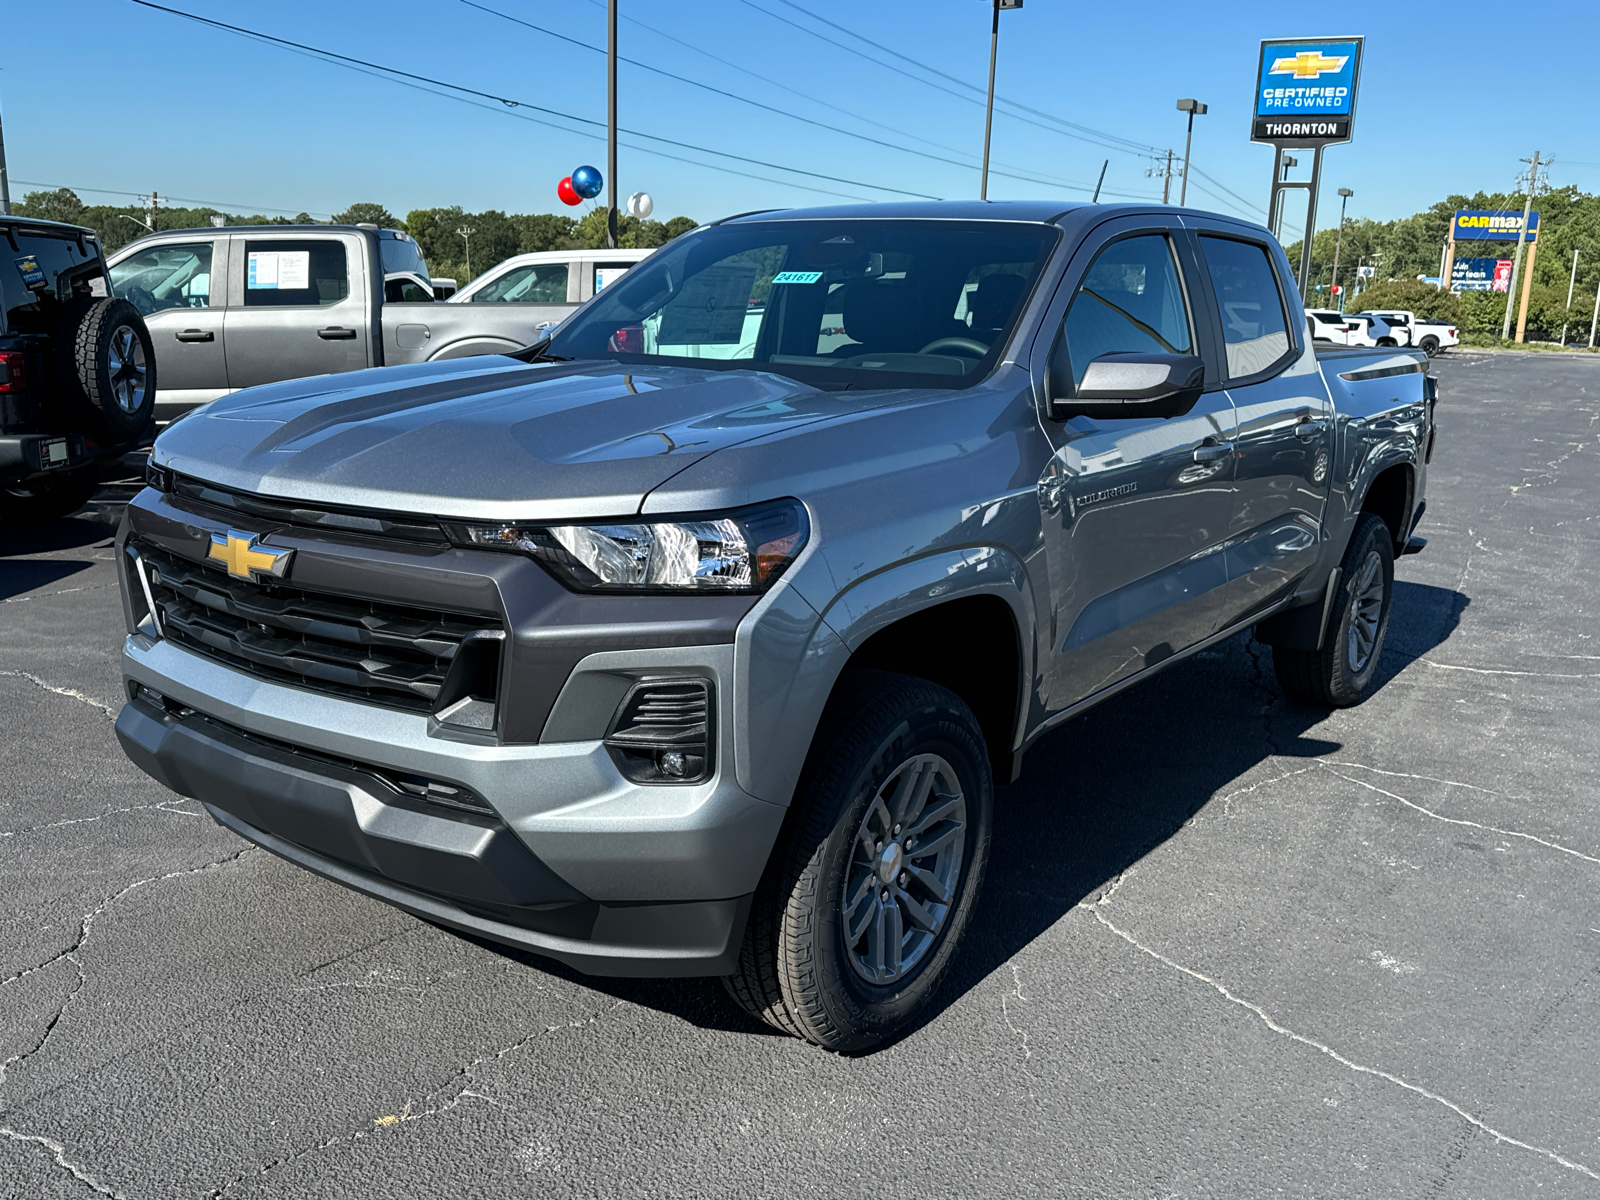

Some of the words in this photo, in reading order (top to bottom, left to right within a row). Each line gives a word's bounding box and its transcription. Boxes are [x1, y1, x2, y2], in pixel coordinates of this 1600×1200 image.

[1263, 87, 1348, 98] CERTIFIED
[1265, 97, 1342, 107] PRE-OWNED
[1266, 123, 1337, 135] THORNTON
[1454, 261, 1469, 270] Join
[776, 273, 820, 282] 241617
[1465, 270, 1486, 278] team
[1077, 481, 1138, 506] COLORADO
